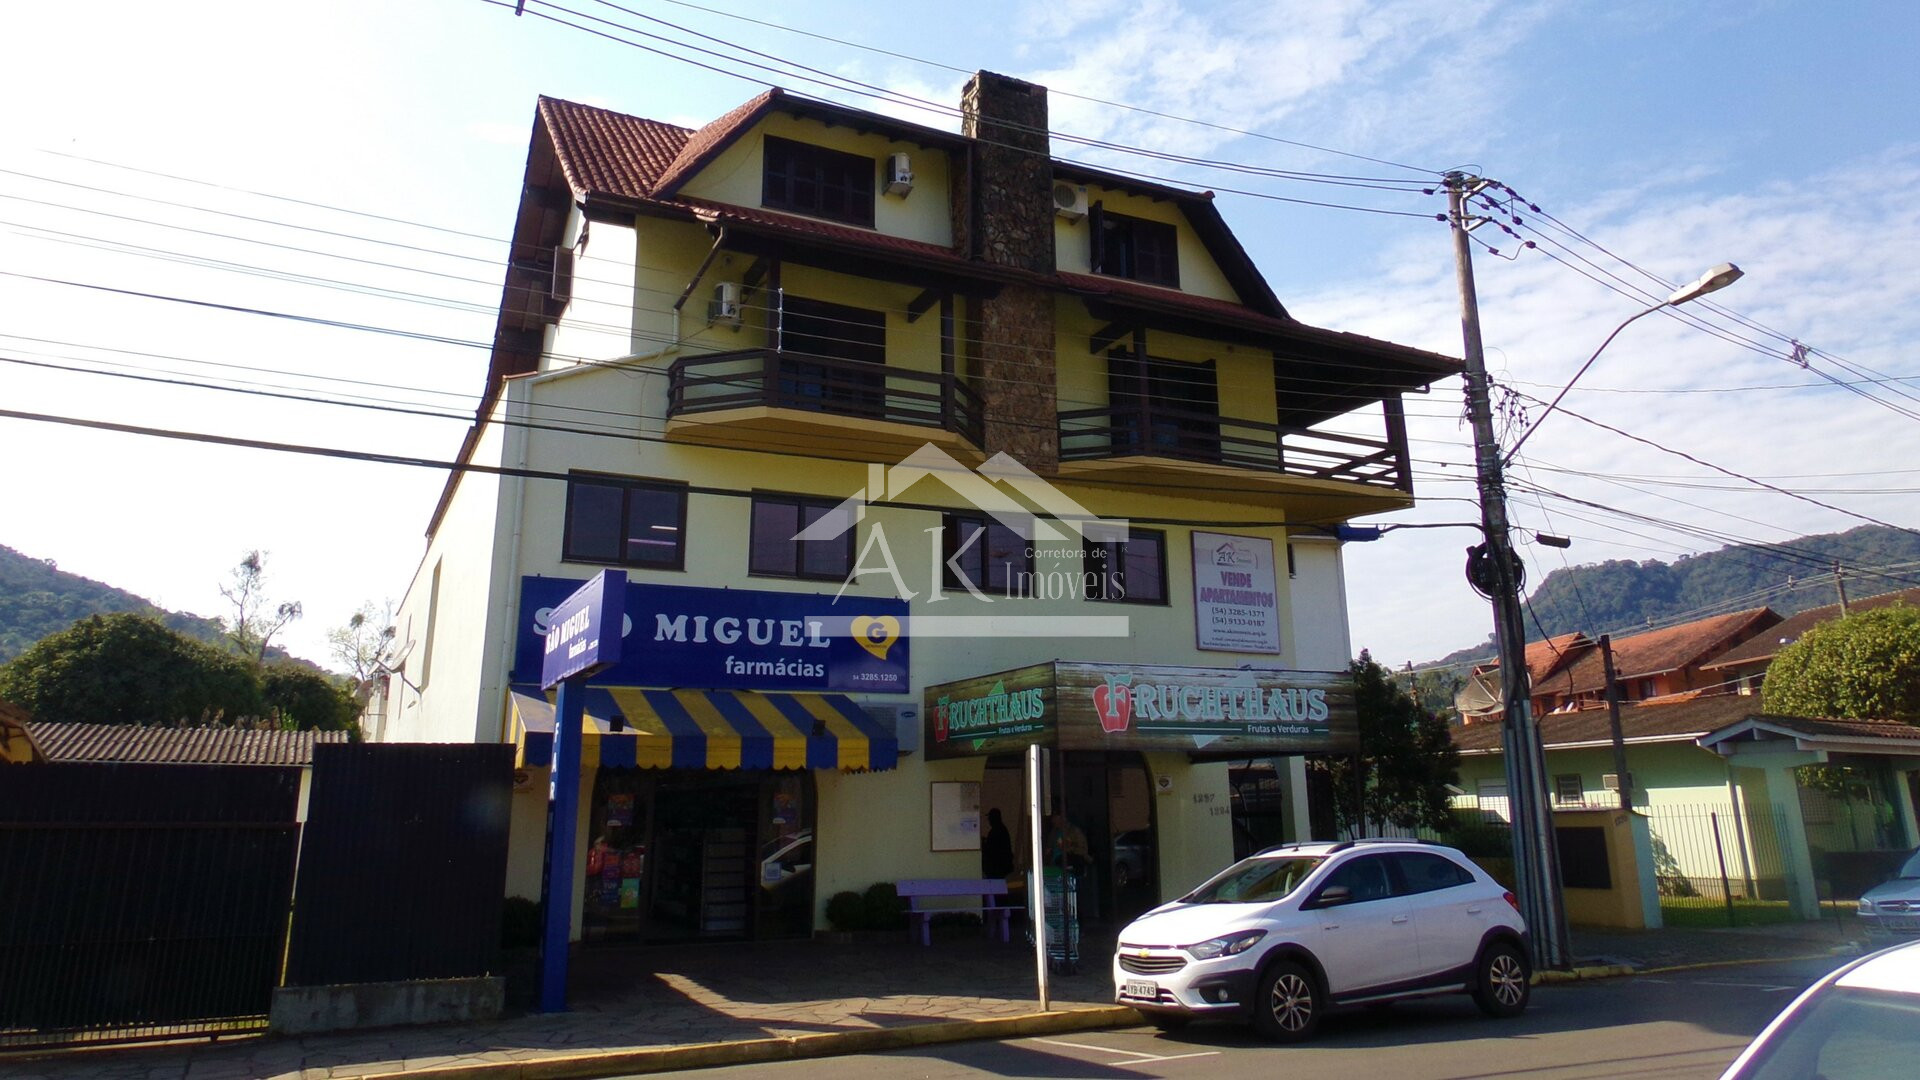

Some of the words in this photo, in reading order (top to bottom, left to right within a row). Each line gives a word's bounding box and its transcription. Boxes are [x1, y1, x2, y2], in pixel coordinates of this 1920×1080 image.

[1220, 571, 1252, 588] VENDE
[1200, 587, 1274, 608] APARTAMENTOS
[1212, 607, 1227, 616] (54)
[1212, 616, 1227, 626] (54)
[560, 605, 590, 645] MIGUEL
[655, 614, 831, 648] MIGUEL
[725, 656, 824, 678] farmácias
[1104, 672, 1329, 721] FRUCHTHAUS
[937, 688, 1044, 731] FRUCHTHAUS
[1248, 725, 1271, 734] Frutas
[1277, 725, 1309, 734] Verduras
